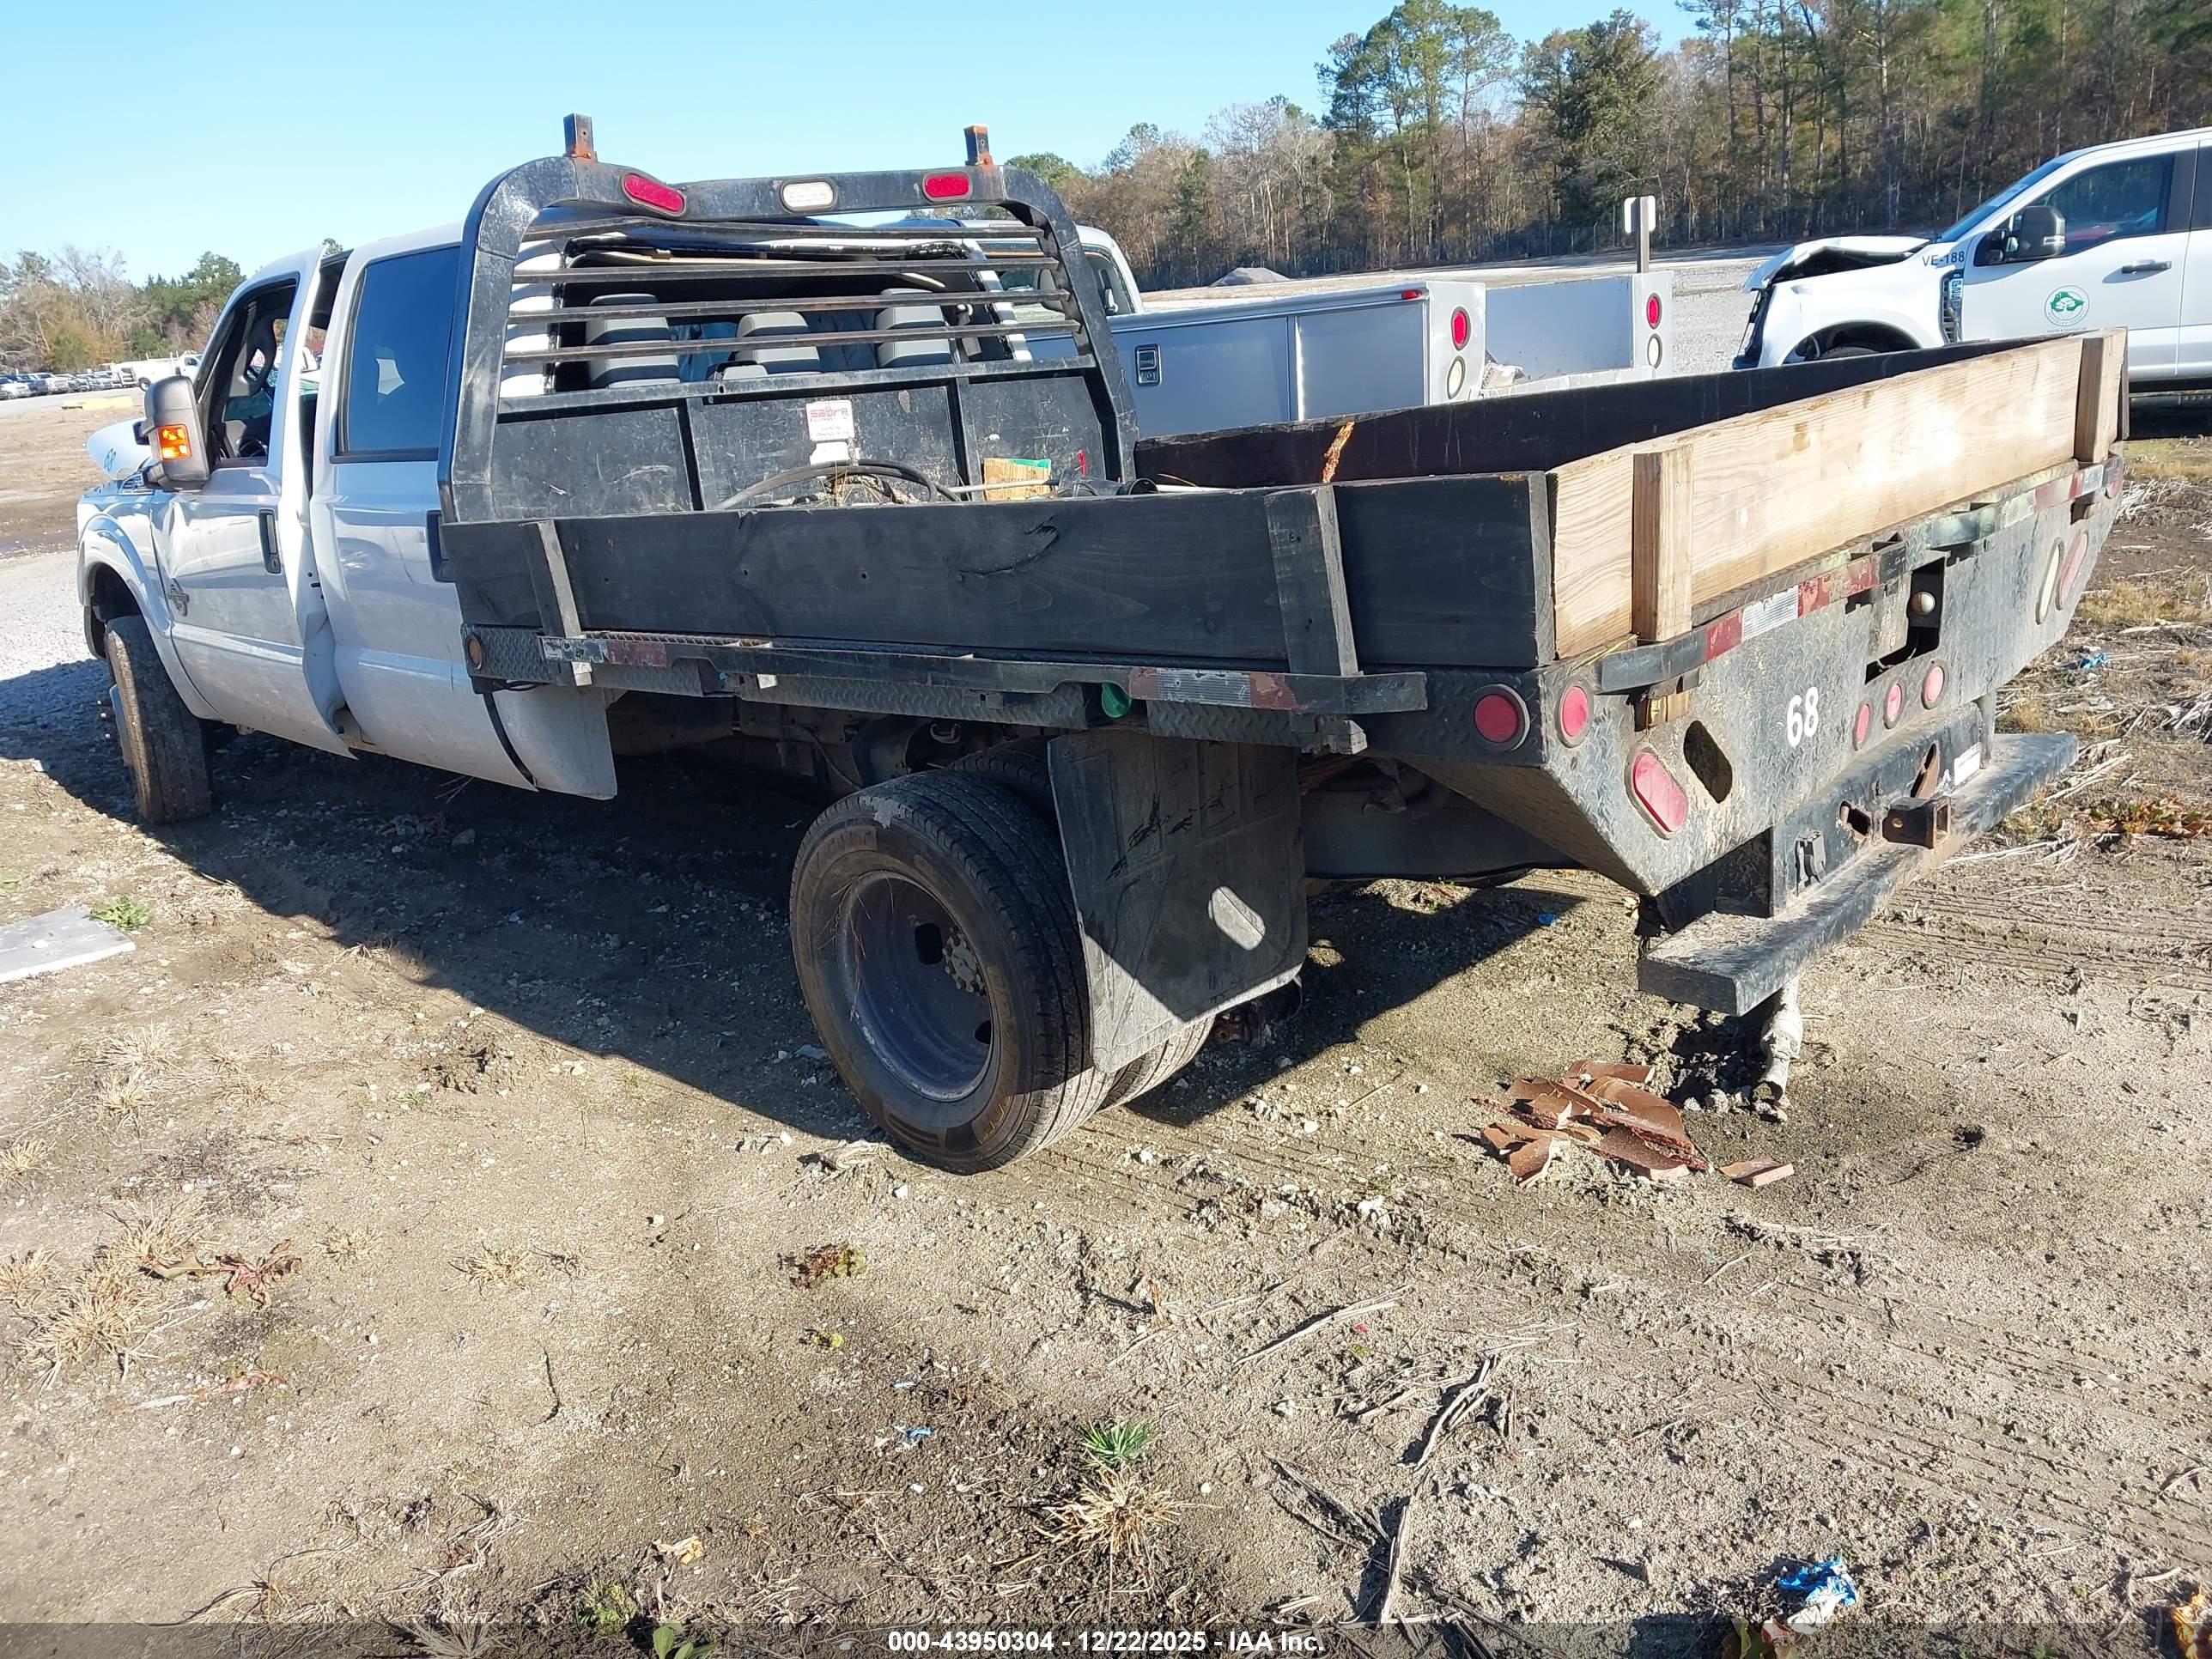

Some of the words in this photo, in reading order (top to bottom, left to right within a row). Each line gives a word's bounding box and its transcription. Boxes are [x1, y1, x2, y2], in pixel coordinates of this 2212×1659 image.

[1922, 251, 1965, 267] VE-188
[104, 447, 117, 471] 68
[1787, 686, 1819, 748] 68
